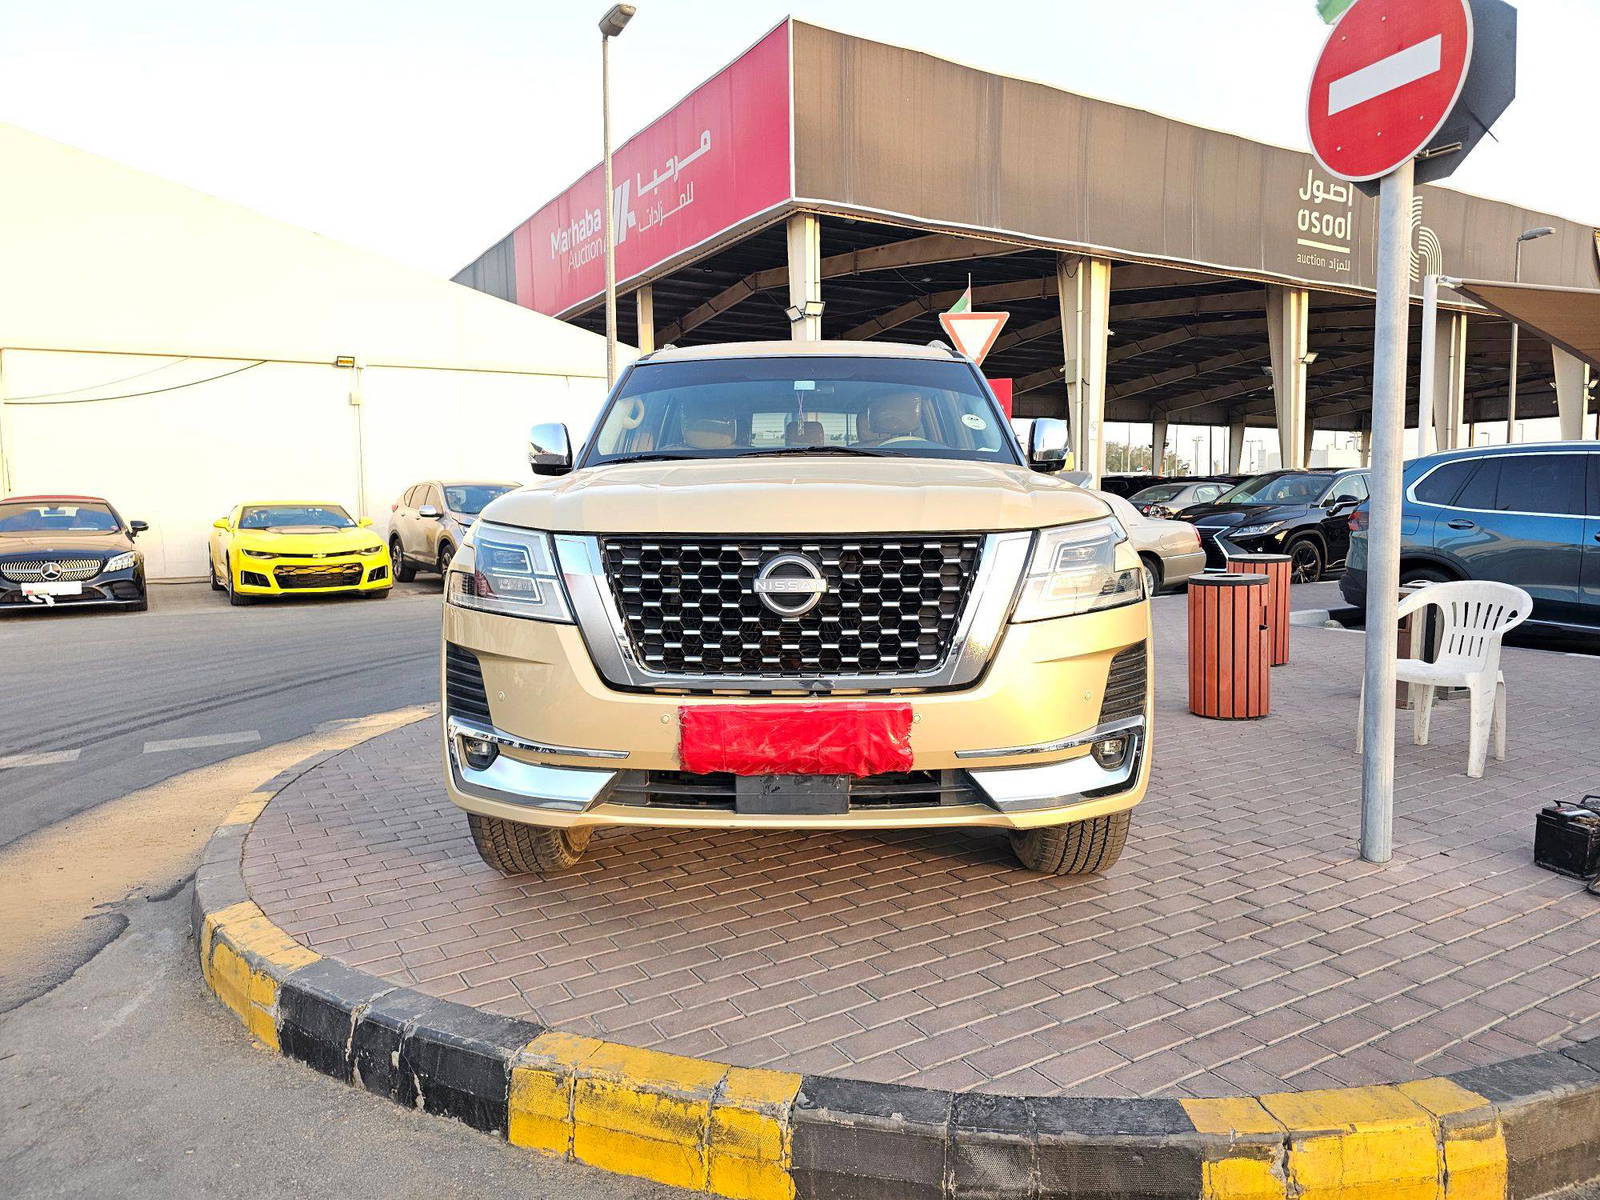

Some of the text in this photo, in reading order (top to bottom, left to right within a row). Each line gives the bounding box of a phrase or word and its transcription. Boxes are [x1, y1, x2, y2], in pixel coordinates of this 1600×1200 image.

[637, 130, 711, 197] مرحبا
[638, 181, 694, 232] للمزادات
[550, 208, 602, 260] Marhaba
[1296, 252, 1351, 273] auction للمزاد
[754, 580, 826, 592] NISSAN
